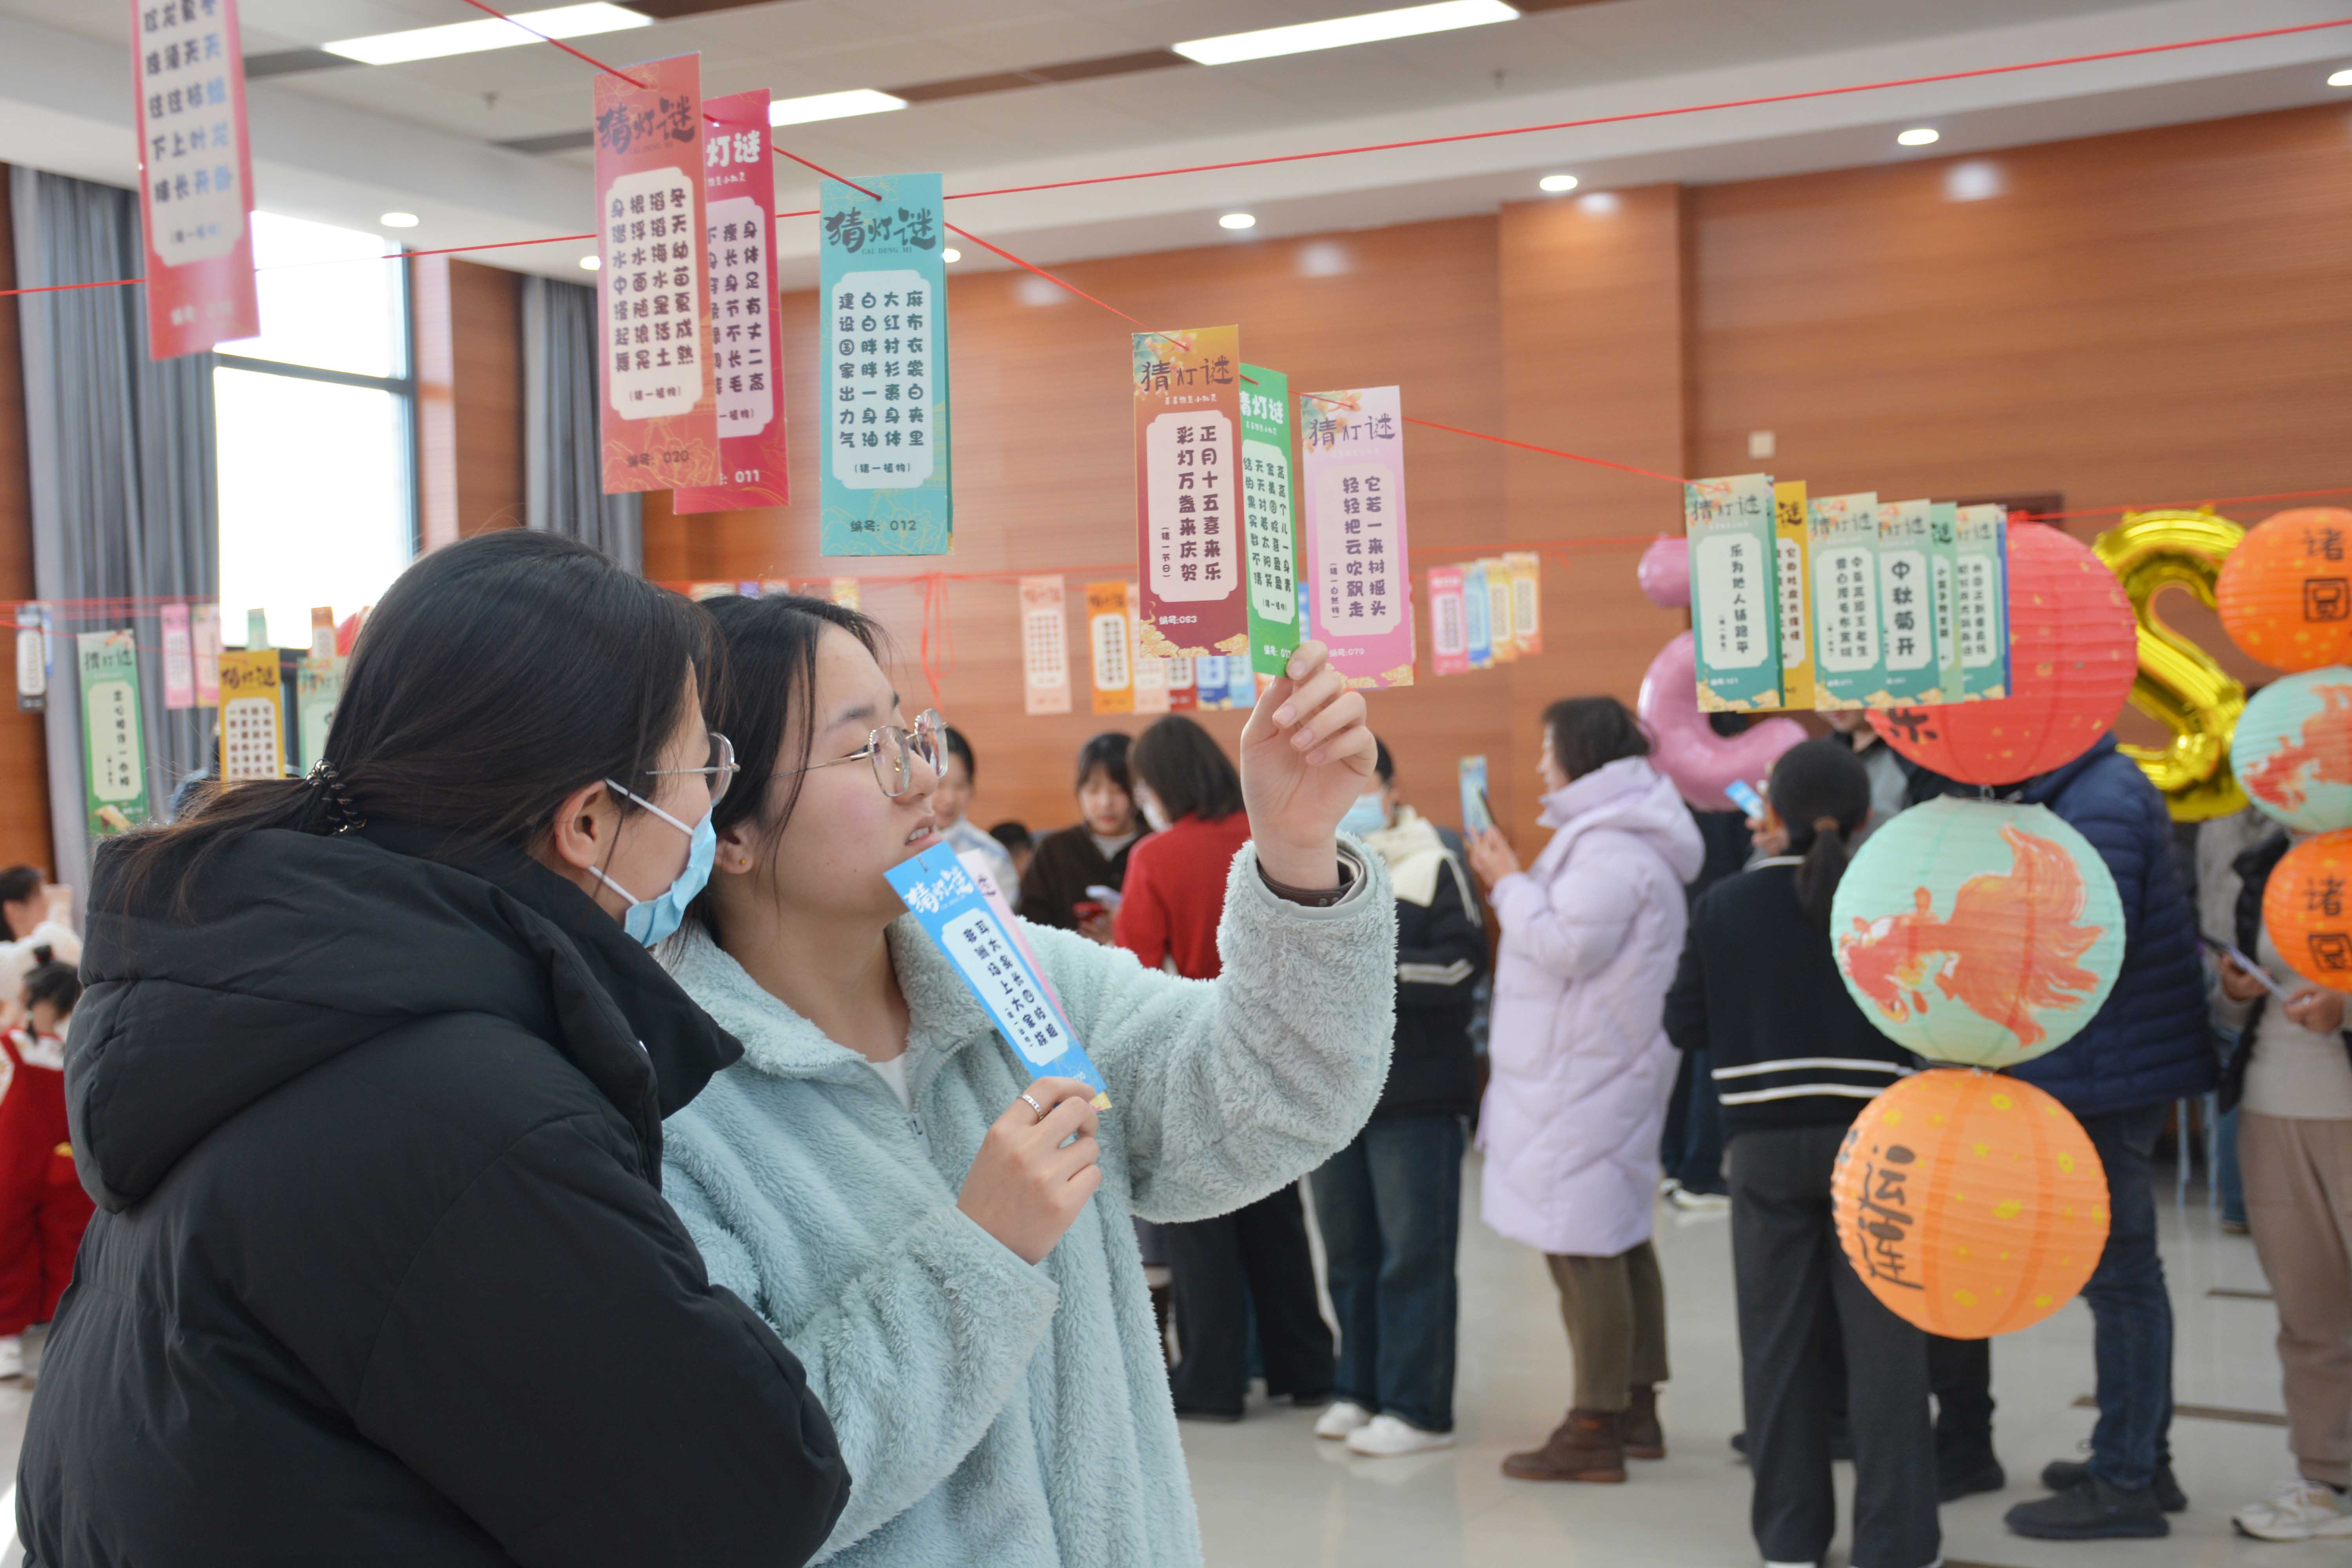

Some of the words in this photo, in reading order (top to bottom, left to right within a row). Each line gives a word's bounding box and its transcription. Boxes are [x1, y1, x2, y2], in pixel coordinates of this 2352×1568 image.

[595, 96, 695, 155] 猜灯谜
[706, 130, 761, 168] 灯谜
[824, 207, 936, 253] 猜灯谜
[671, 188, 693, 365] 冬天幼苗夏成熟
[838, 293, 855, 448] 建设国家出力气
[861, 292, 878, 448] 白白胖胖一身油
[884, 292, 902, 447] 大红衬衫裹身体
[906, 290, 924, 446] 麻布衣裳白夹里
[1141, 355, 1234, 392] 猜灯谜
[663, 450, 689, 463] 020
[1309, 413, 1396, 447] 猜灯谜
[735, 470, 760, 483] 011
[854, 463, 911, 473] (猜一植物)
[850, 520, 880, 532] 编号:
[890, 520, 916, 531] 012
[1176, 426, 1198, 581] 彩灯万盏来庆贺
[1200, 425, 1221, 581] 正月十五喜来乐
[1243, 457, 1262, 586] 结的果实数不清
[1255, 459, 1272, 588] 天天对着太阳笑
[1276, 465, 1291, 592] 高高个儿一身青
[1692, 494, 1760, 521] 猜灯谜
[1161, 527, 1171, 577] (猜一节日)
[1343, 477, 1364, 617] 轻轻把云吹飘走
[1365, 475, 1386, 616] 它若一来树摇头
[1329, 648, 1365, 657] 编号:079
[904, 865, 975, 914] 猜灯谜
